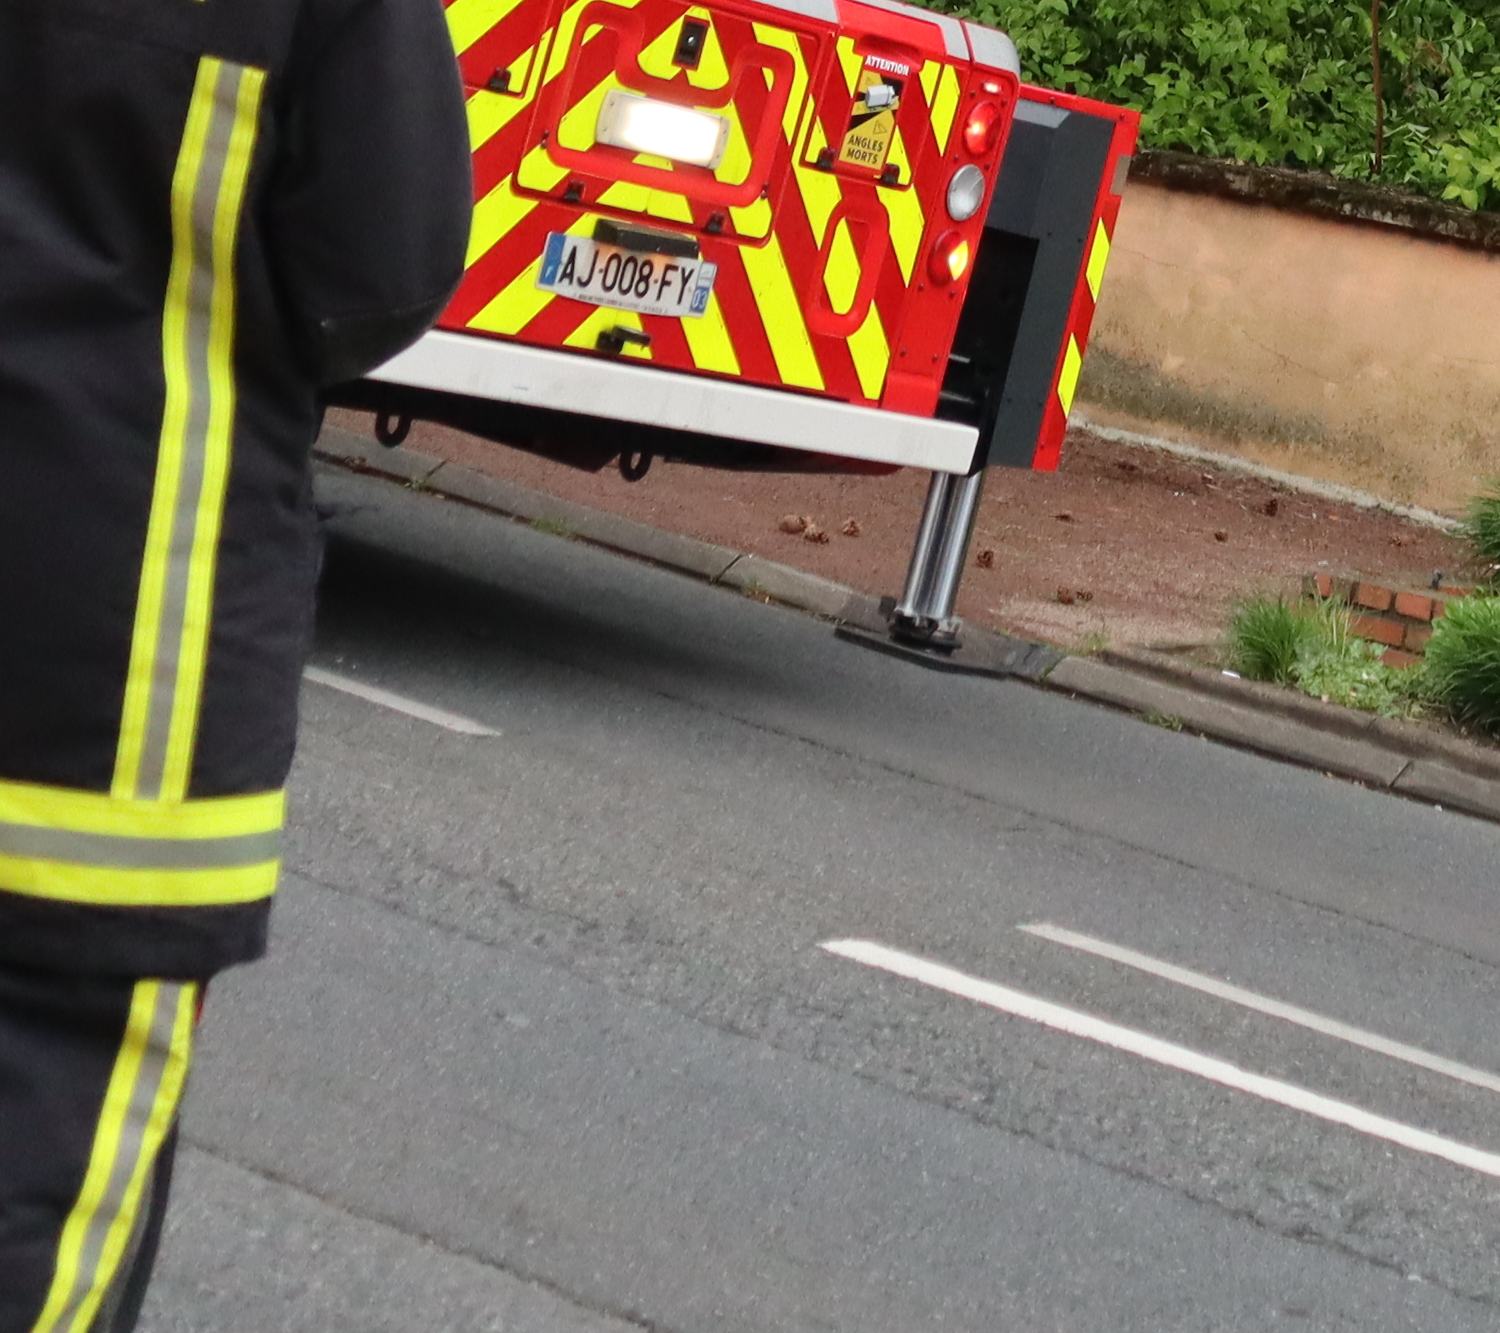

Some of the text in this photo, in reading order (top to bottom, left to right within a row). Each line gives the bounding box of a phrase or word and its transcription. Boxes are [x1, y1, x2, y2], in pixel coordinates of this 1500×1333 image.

[865, 55, 911, 76] ATTENTION
[847, 134, 884, 152] ANGLES
[846, 148, 879, 165] MORTS
[692, 290, 707, 310] 03
